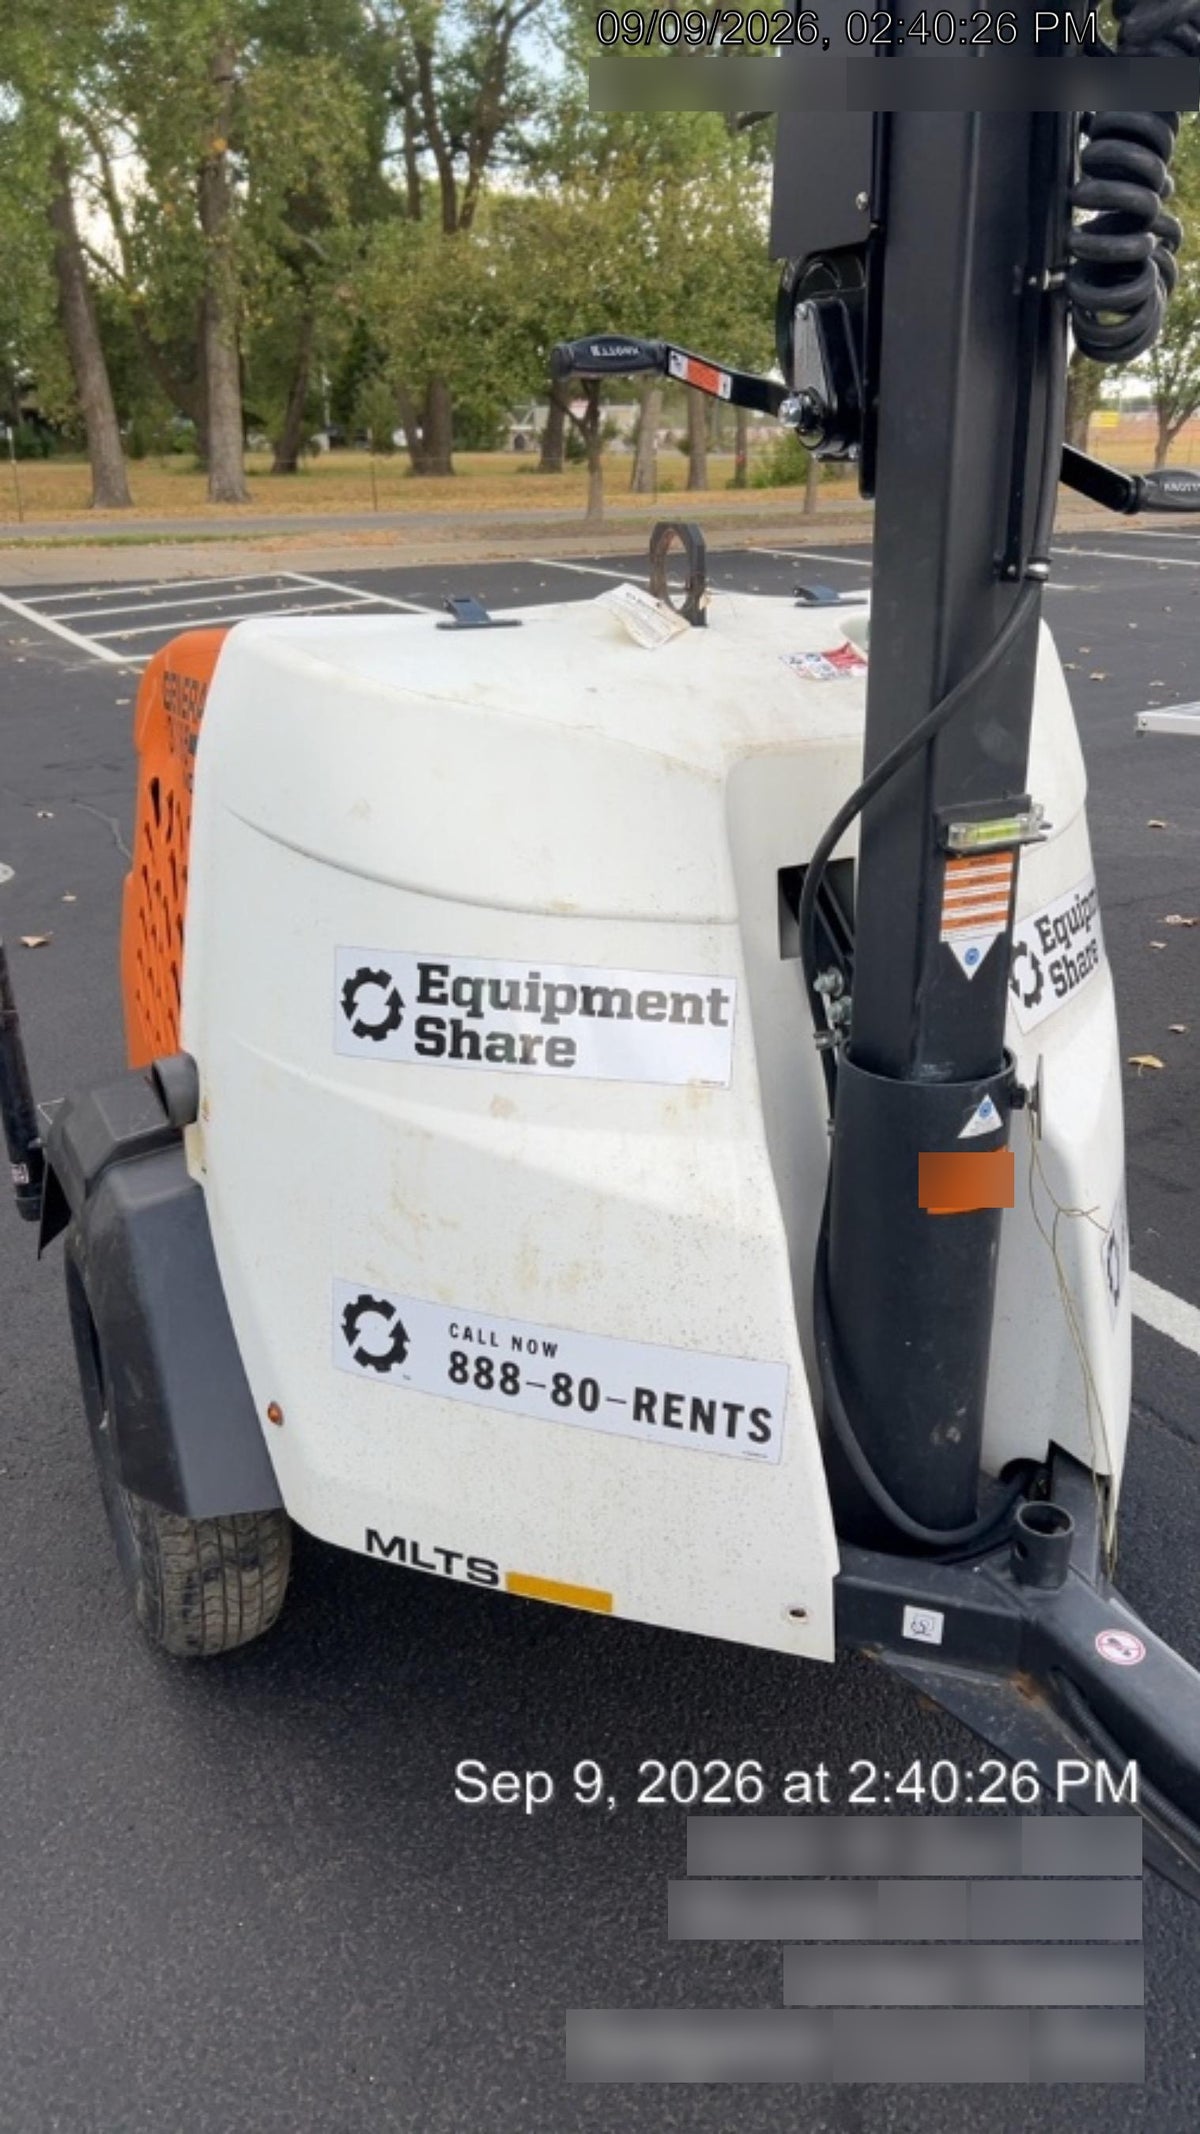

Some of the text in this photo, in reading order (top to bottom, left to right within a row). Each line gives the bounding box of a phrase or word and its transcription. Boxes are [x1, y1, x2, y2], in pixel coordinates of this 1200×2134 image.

[416, 962, 729, 1027] Equipment
[414, 1015, 577, 1068] Share
[448, 1322, 559, 1359] CALL NOW
[365, 1527, 500, 1586] MLTS
